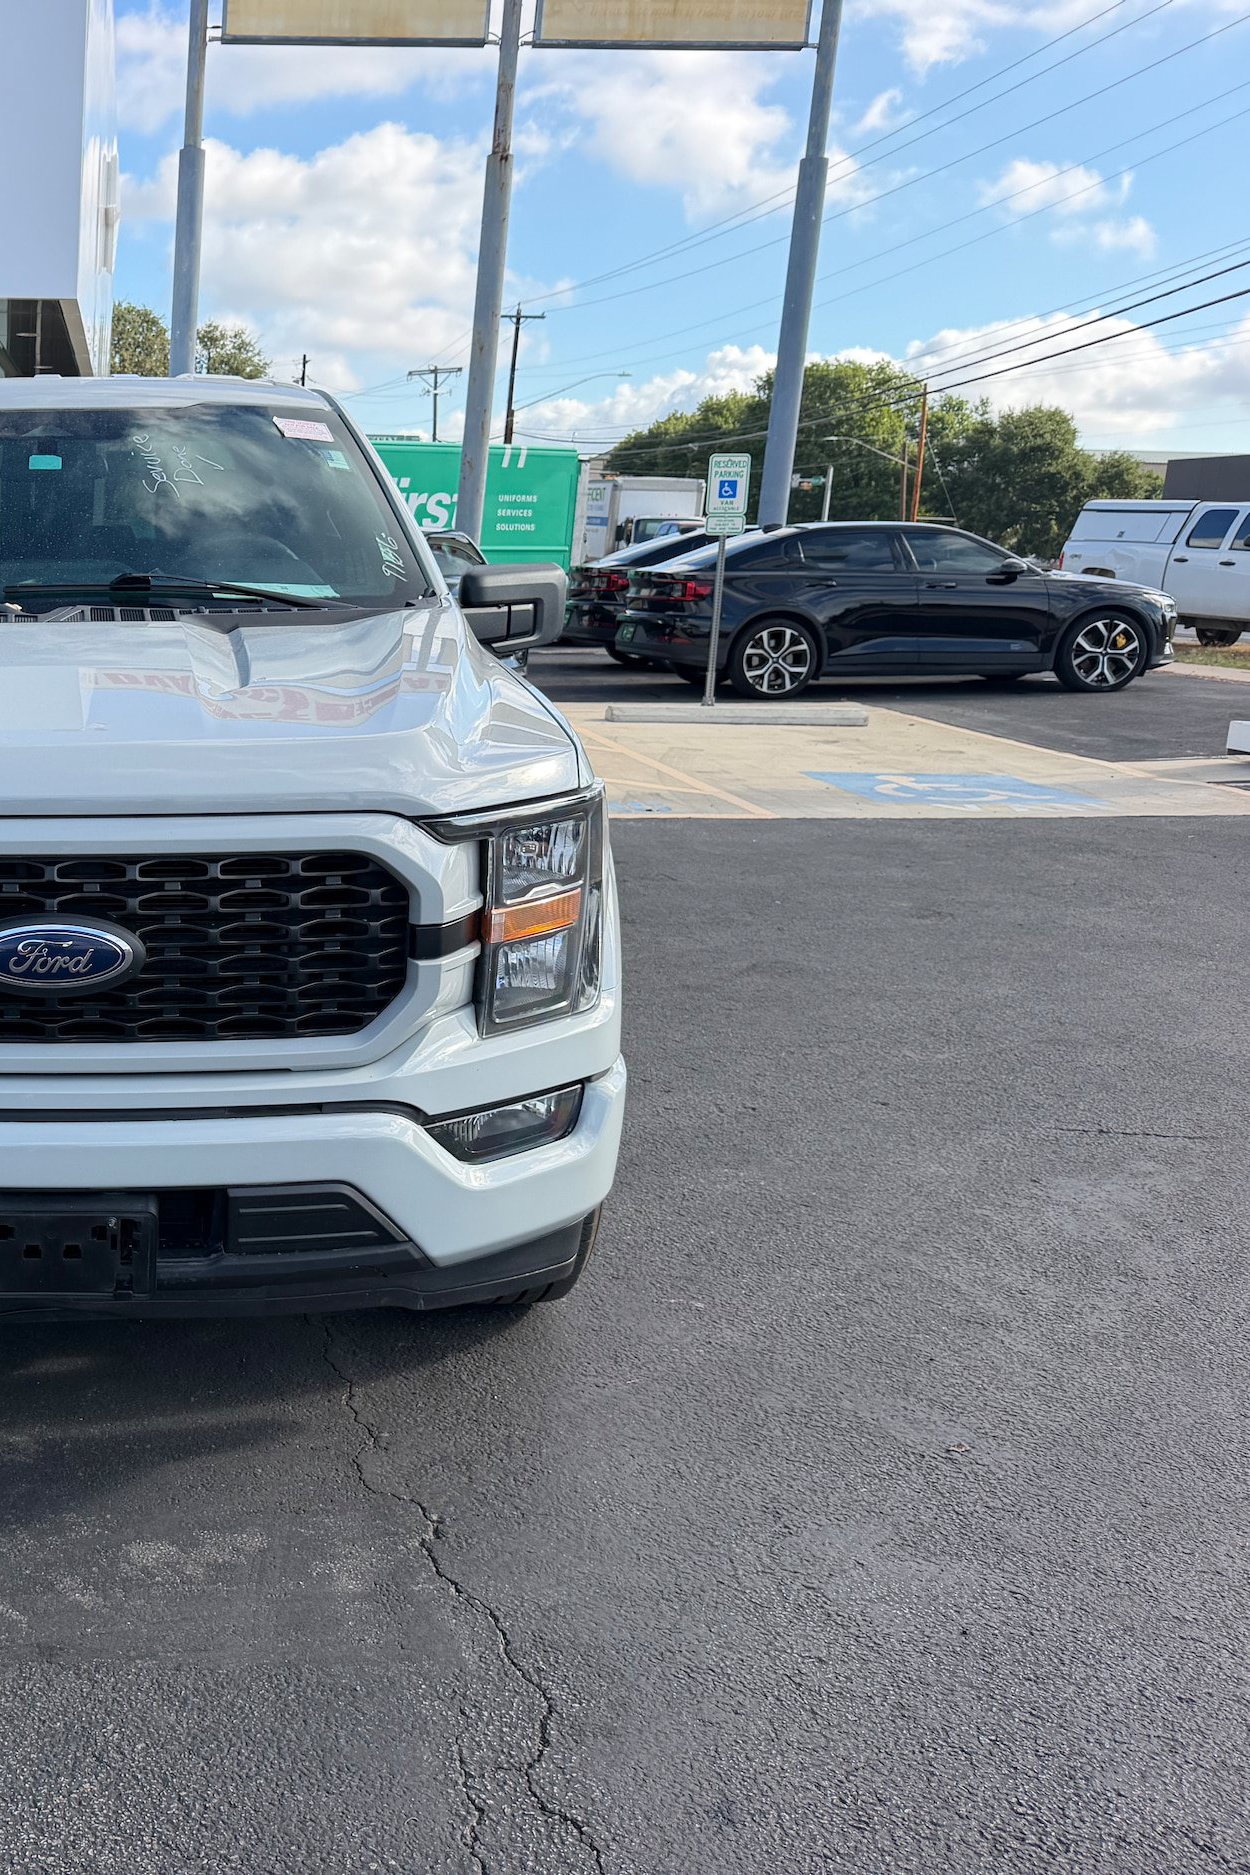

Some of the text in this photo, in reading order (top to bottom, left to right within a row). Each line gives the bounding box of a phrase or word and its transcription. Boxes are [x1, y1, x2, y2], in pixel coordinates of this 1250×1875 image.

[172, 445, 205, 486] Done
[713, 460, 748, 469] RESERVED
[713, 470, 744, 478] PARKING
[498, 494, 538, 503] UNIFORMS
[497, 508, 533, 517] SERVICES
[495, 523, 536, 532] SOLUTIONS
[8, 939, 95, 974] Ford
